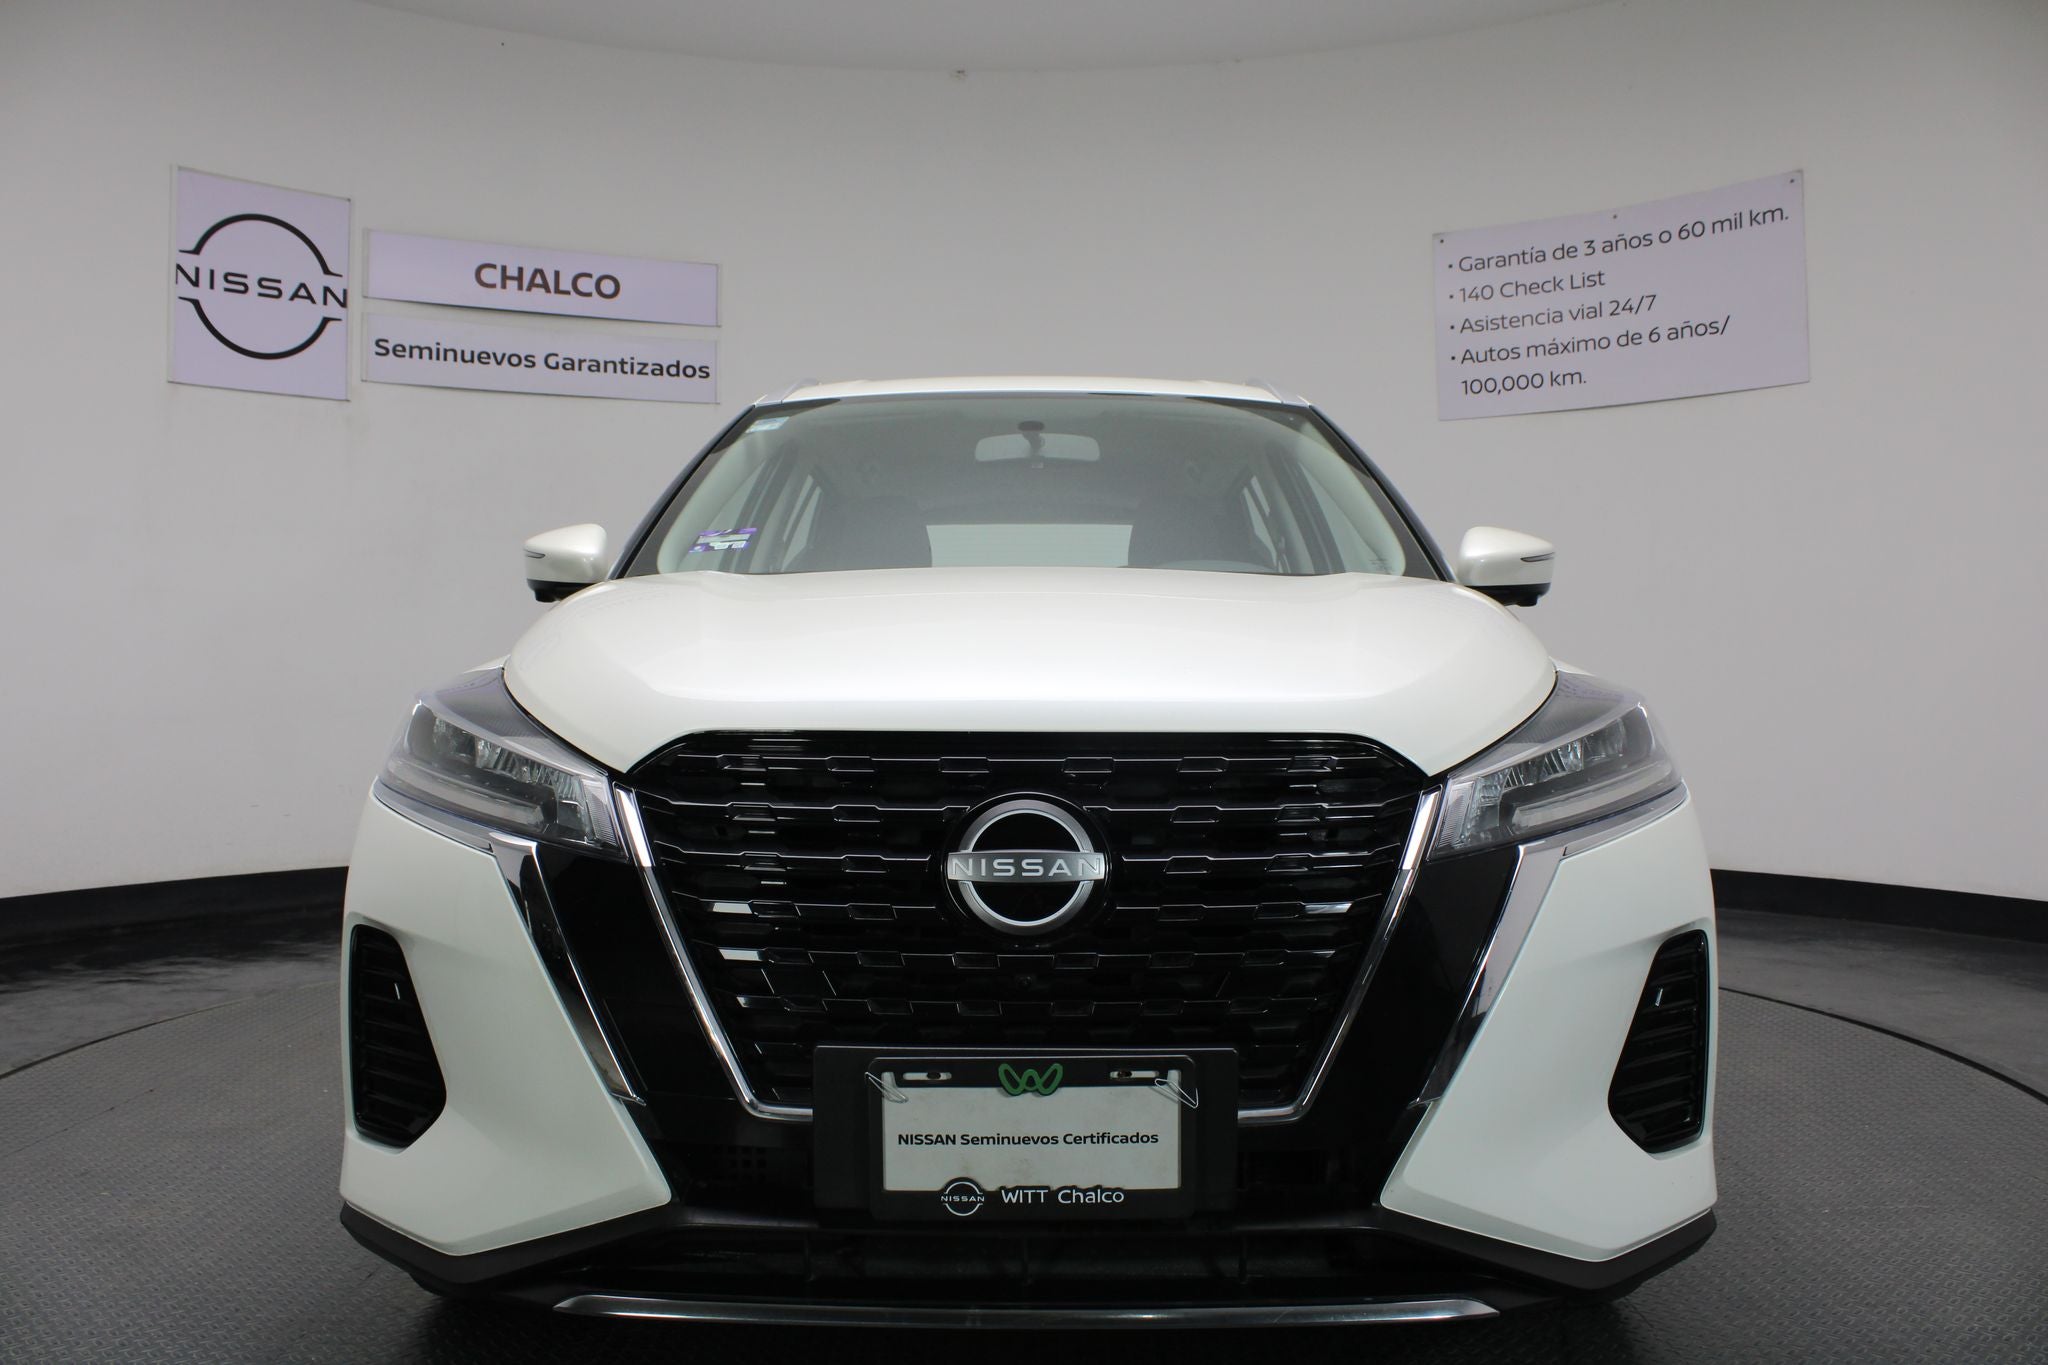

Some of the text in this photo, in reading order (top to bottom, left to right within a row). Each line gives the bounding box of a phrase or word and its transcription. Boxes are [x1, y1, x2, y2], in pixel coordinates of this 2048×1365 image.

[1459, 206, 1789, 272] Garantía de 3 años o 60 mil km.
[175, 263, 348, 308] NISSAN
[474, 262, 621, 300] CHALCO
[1459, 270, 1606, 304] 140 Check List
[1460, 294, 1657, 334] Asistencia vial 24/7
[374, 337, 711, 380] Seminuevos Garantizados
[1460, 315, 1731, 365] Autos máximo de 6 años/
[1461, 369, 1587, 397] 100,000 km.
[952, 858, 1101, 877] NISSAN
[897, 1132, 1159, 1146] NISSAN Seminuevos Certificados
[1001, 1188, 1125, 1204] WITT Chalco
